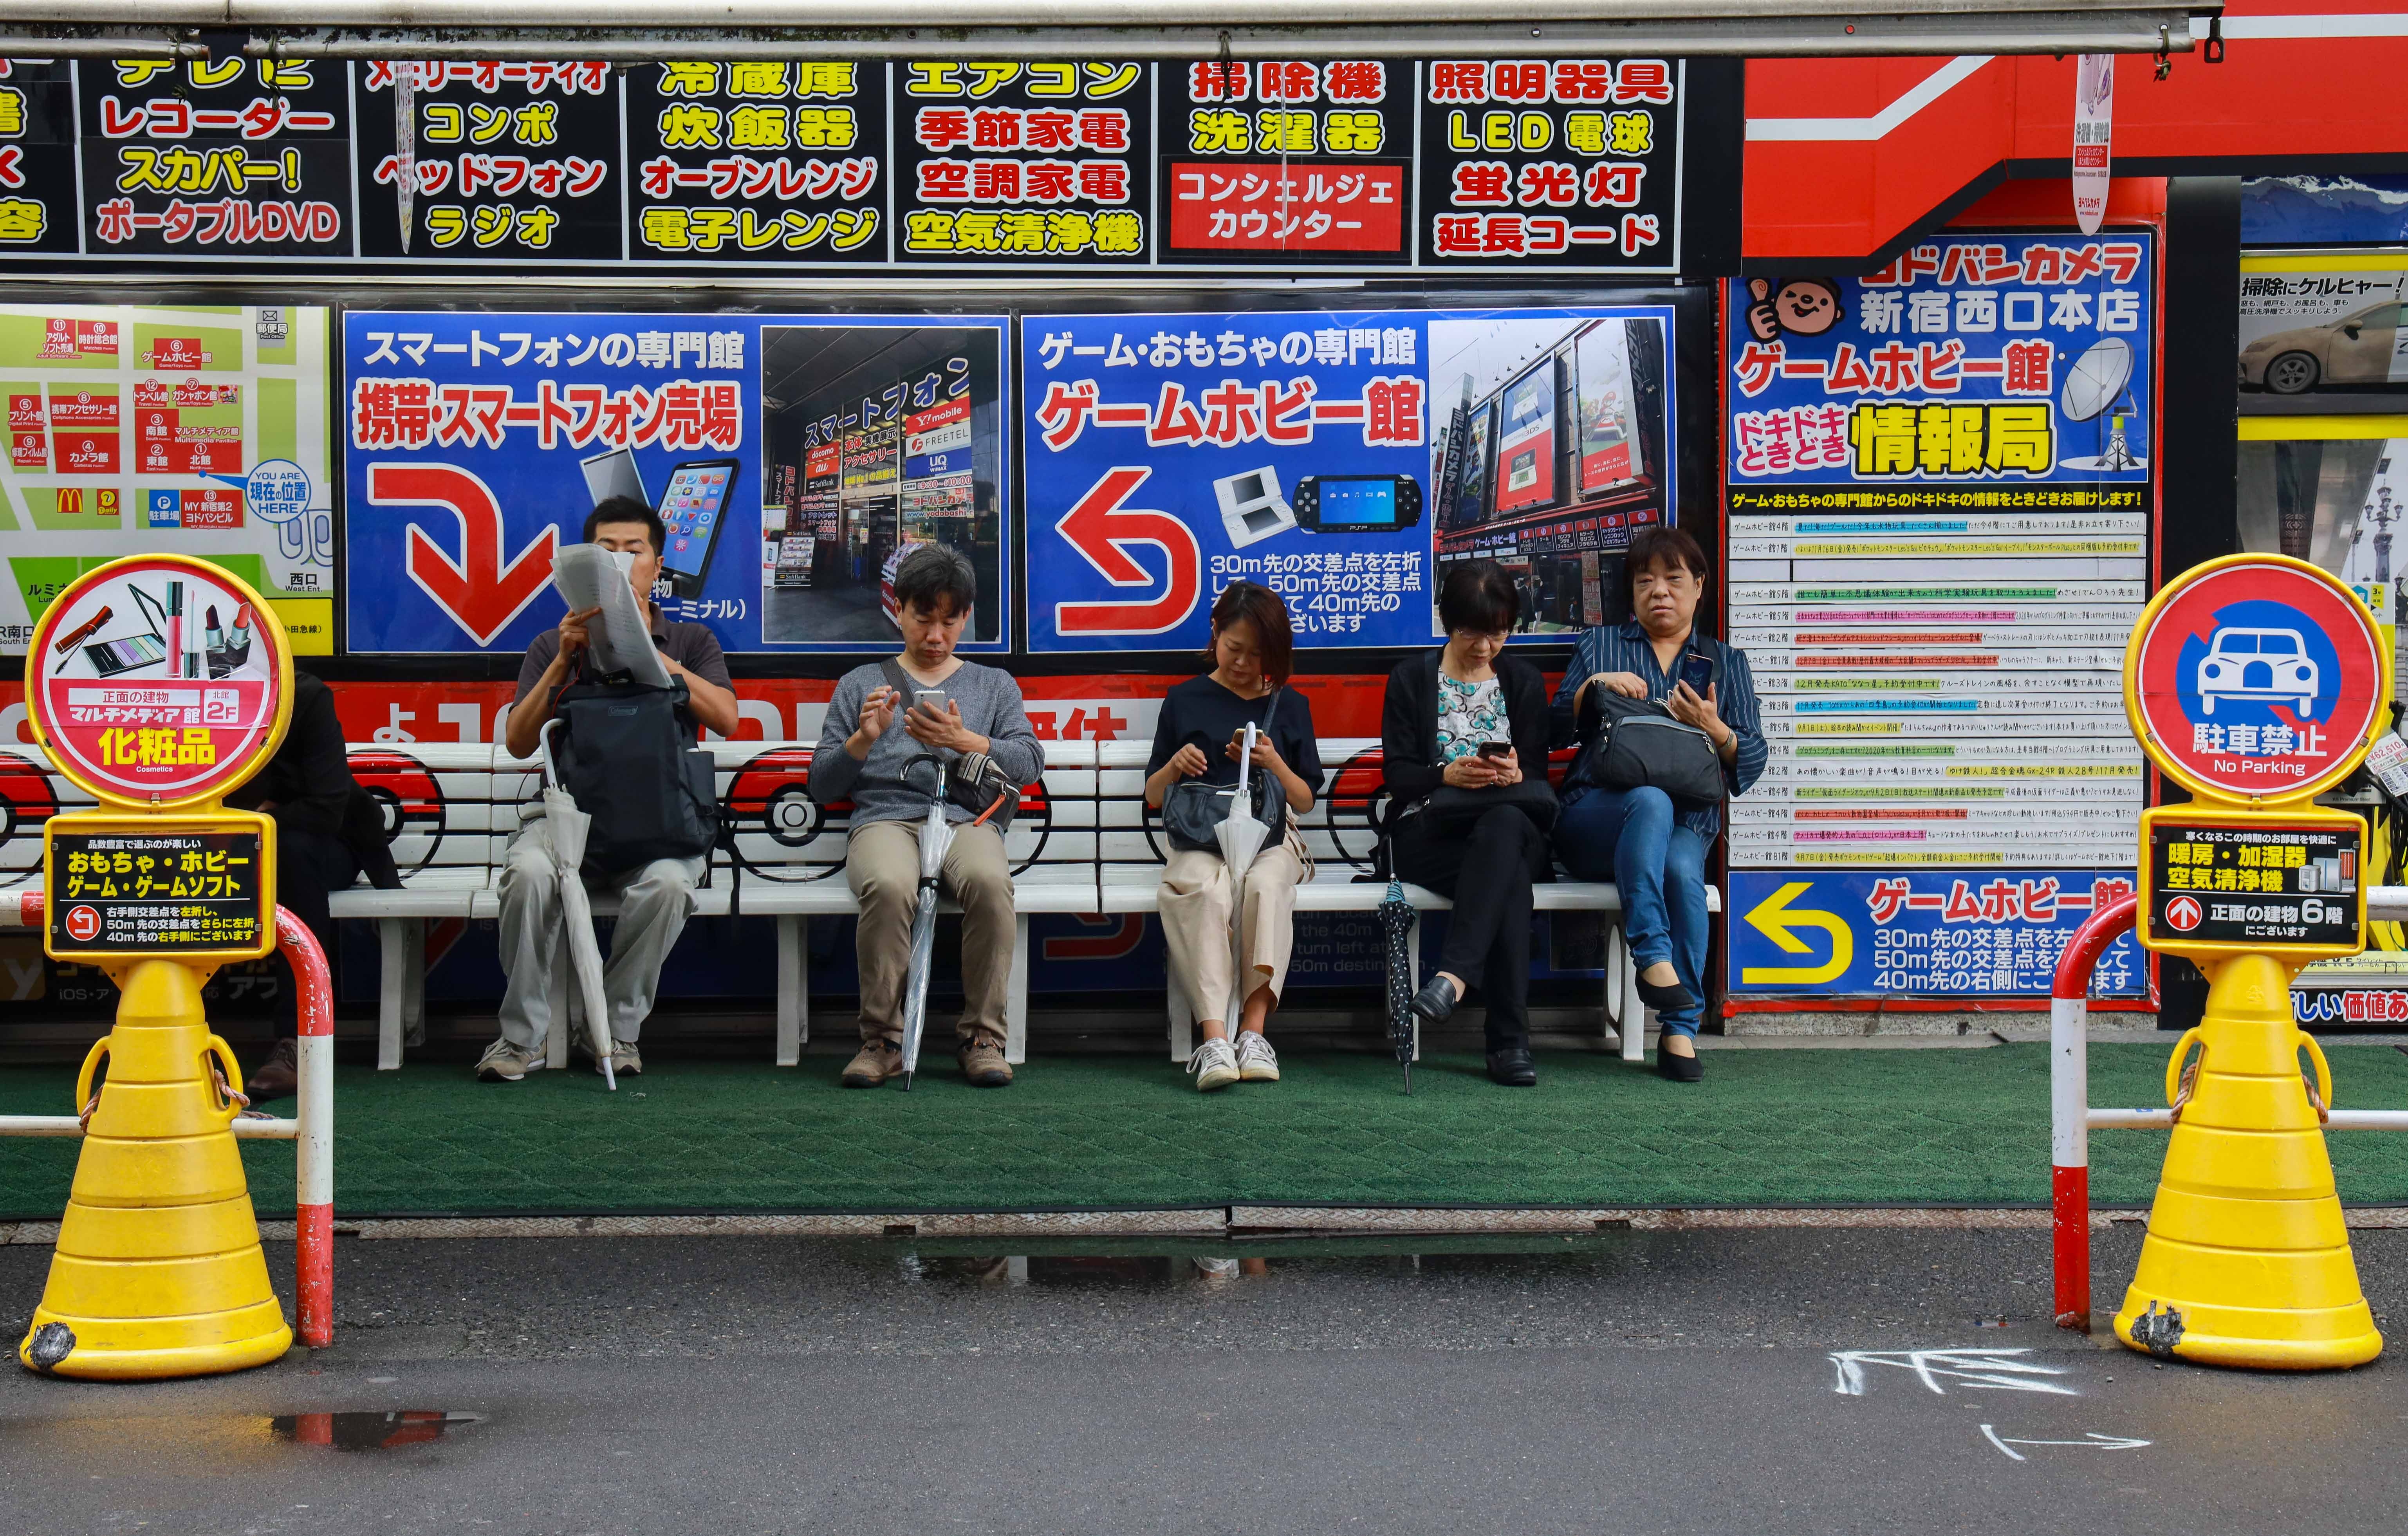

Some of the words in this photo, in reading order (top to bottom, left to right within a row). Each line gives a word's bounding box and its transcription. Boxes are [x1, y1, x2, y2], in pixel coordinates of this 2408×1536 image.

[906, 63, 1141, 99] エアコン
[1189, 61, 1385, 103] 掃除機
[1428, 60, 1673, 104] 照明器具
[102, 96, 334, 139] レコーダー
[424, 101, 558, 146] コンポ
[658, 103, 858, 150] 炊飯器
[916, 106, 1130, 152] 季節家電
[118, 146, 301, 194] スカパー!
[374, 153, 607, 197] ヘッドフォン
[641, 156, 878, 199] オーブンレンジ
[917, 158, 1130, 204] 空調家電
[1451, 161, 1646, 207] 蛍光灯
[97, 198, 340, 244] ポータブルDVD
[425, 204, 560, 249] ラジオ
[640, 206, 879, 252] 電子レンジ
[904, 208, 1143, 254] 空気清浄機
[1209, 209, 1362, 239] カウンター
[1433, 213, 1660, 257] 延長コード
[2241, 277, 2404, 297] 掃除にケルヒャー!
[1860, 290, 2139, 333] 新宿西口本店
[256, 323, 288, 334] 郵便局
[141, 352, 213, 363] ゲームホビー館
[363, 330, 744, 369] スマートフォンの専門館
[1038, 328, 1417, 370] ゲーム・おもちゃの専門館
[1735, 339, 2053, 399] ゲームホビー館
[133, 391, 168, 402] トラベル館
[9, 410, 44, 421] プリント館
[353, 377, 742, 451] 携帯・スマートフォン売場
[1034, 375, 1426, 453] ゲームホビー館
[146, 426, 168, 436] 南館
[174, 427, 240, 435] マルチメディア館
[926, 429, 968, 446] FREETEL
[1847, 400, 2057, 479] 情報局
[70, 453, 109, 463] カメラ館
[147, 456, 168, 466] 東館
[190, 455, 211, 465] 北館
[816, 463, 829, 473] au
[250, 482, 307, 502] 現在の位置
[149, 511, 181, 521] 駐車場
[184, 502, 199, 511] MY
[186, 513, 233, 523] ヨドバシビル
[258, 503, 298, 514] HERE
[1210, 551, 1422, 574] 30m先の交差点を左折
[290, 572, 317, 586] 西口
[102, 690, 169, 704] 正面の建物
[213, 690, 229, 699] 北館
[206, 701, 237, 720] 2F
[98, 727, 216, 766] 化粧品
[2193, 723, 2328, 757] 駐車禁止
[2214, 760, 2237, 773] No
[2241, 760, 2306, 776] Parking
[88, 839, 201, 849] 品数豊富で選ぶのが楽しい
[2186, 831, 2337, 845] 寒くなるこの時期のお部屋を快適に
[69, 850, 249, 873] おもちゃ・ホビー
[2168, 843, 2306, 868] 暖房・加湿器
[67, 875, 240, 898] ゲーム・ゲームソフト
[2168, 866, 2283, 893] 空気清浄機
[107, 906, 218, 918] 右手側交差点を左折し、
[2245, 925, 2308, 937] にございます
[1337, 941, 1364, 955] left
